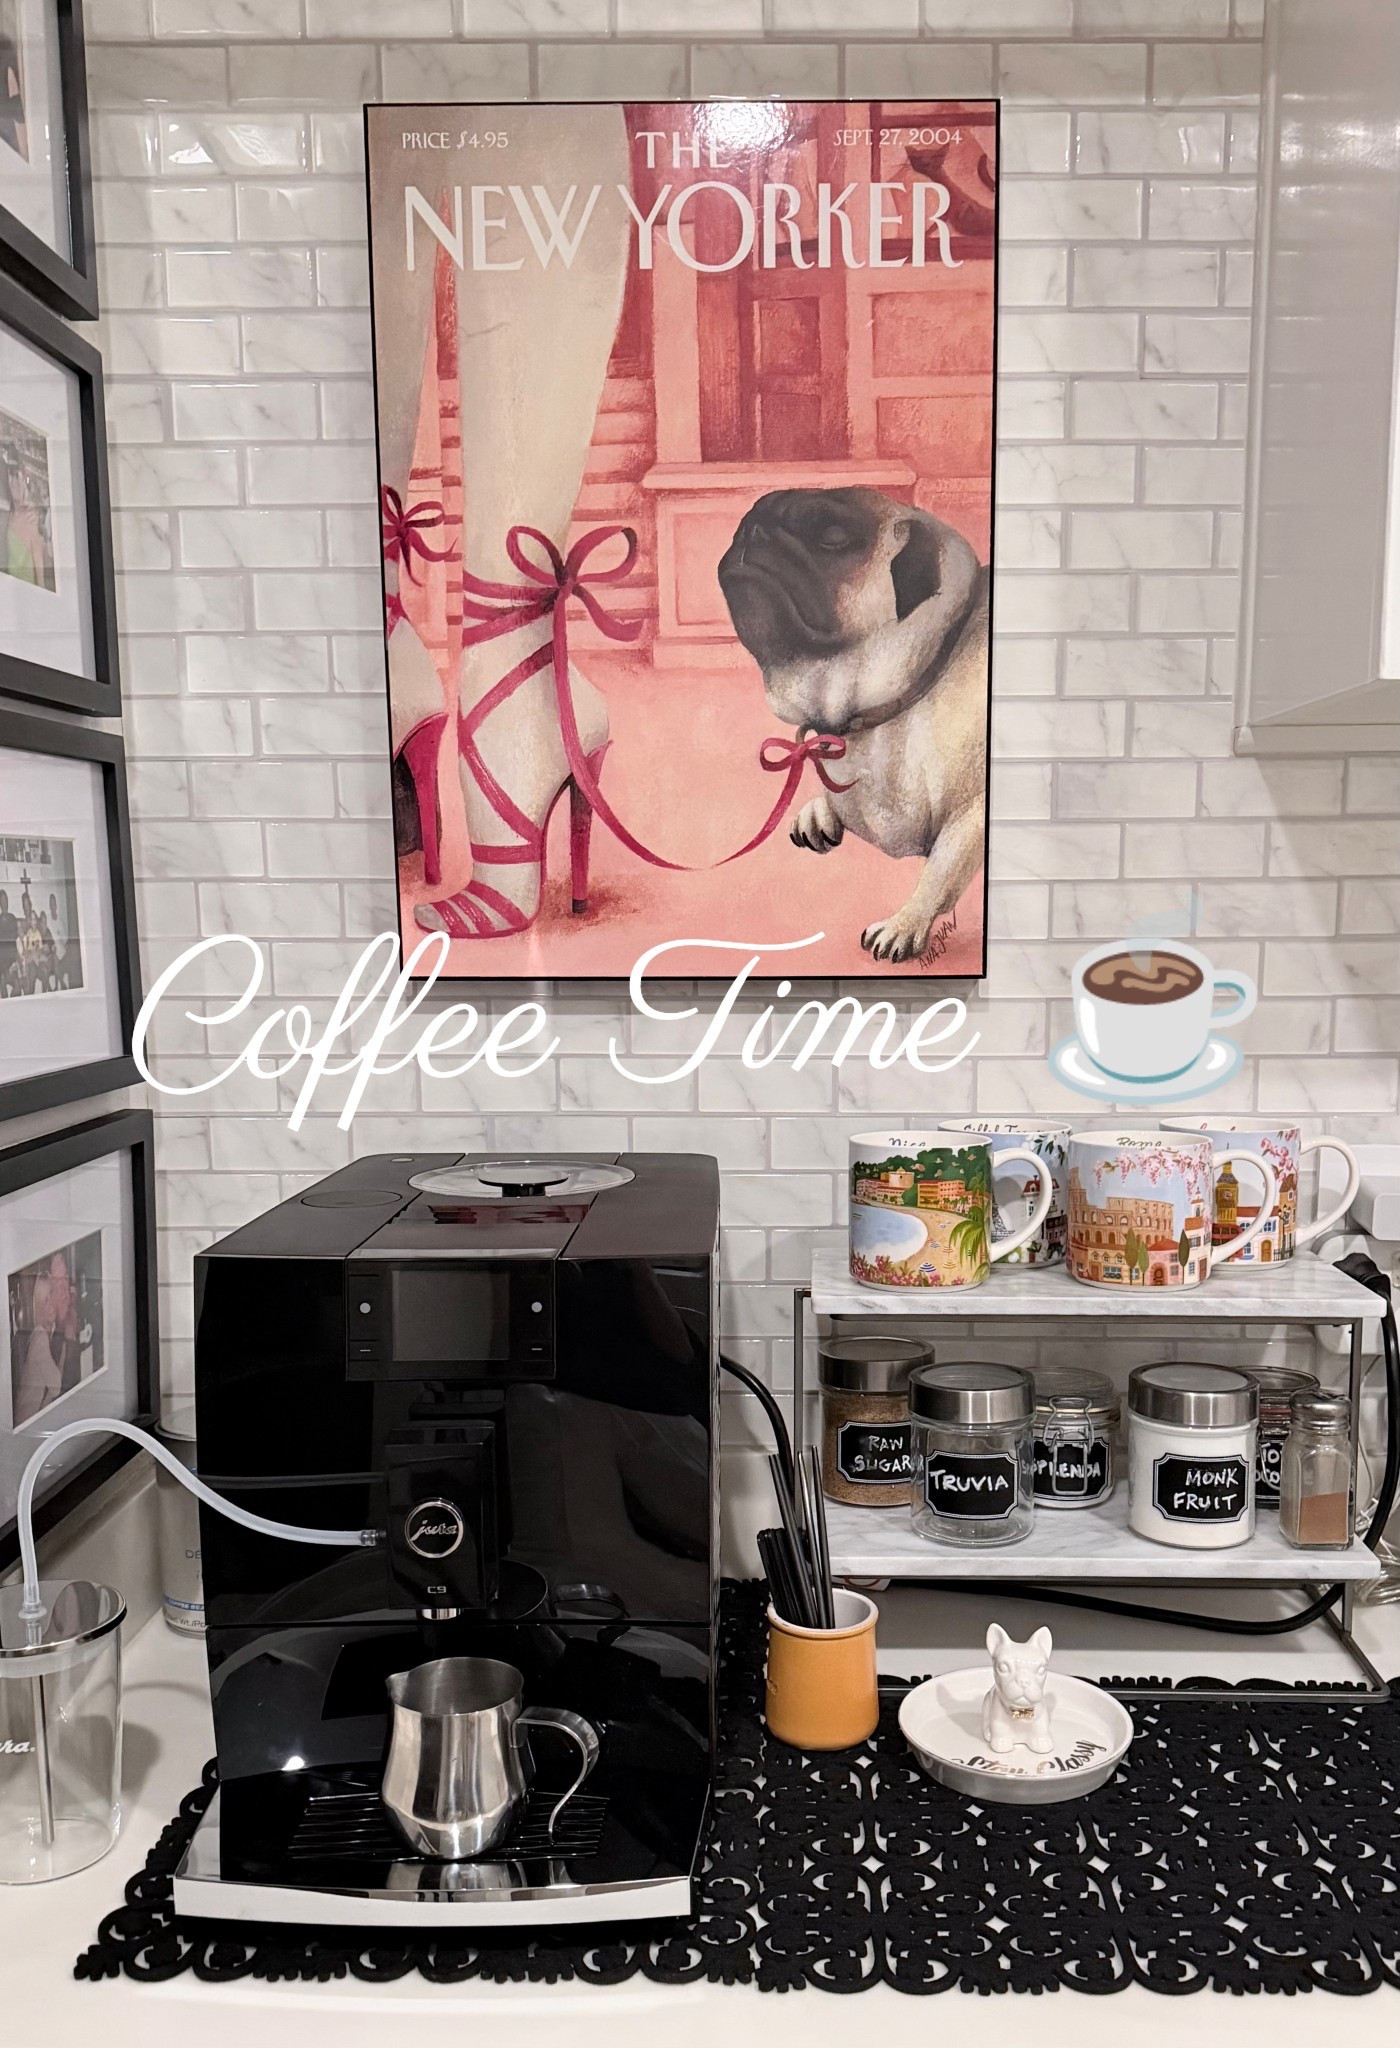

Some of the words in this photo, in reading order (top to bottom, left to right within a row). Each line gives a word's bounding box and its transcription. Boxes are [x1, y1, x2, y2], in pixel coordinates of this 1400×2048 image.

[401, 131, 452, 149] PRICE
[456, 130, 509, 149] $4.95
[833, 128, 874, 146] SEPT.
[879, 128, 903, 147] 27,
[908, 128, 963, 145] 2004
[634, 131, 732, 169] THE
[404, 184, 602, 271] NEW
[617, 180, 964, 273] YORKER
[868, 1435, 903, 1452] RAW
[854, 1455, 911, 1473] SUGAR
[928, 1469, 1009, 1492] TRUVIA
[1185, 1467, 1239, 1488] MONK
[1173, 1491, 1238, 1511] FRUIT
[410, 1519, 459, 1542] jura
[427, 1585, 447, 1594] C9
